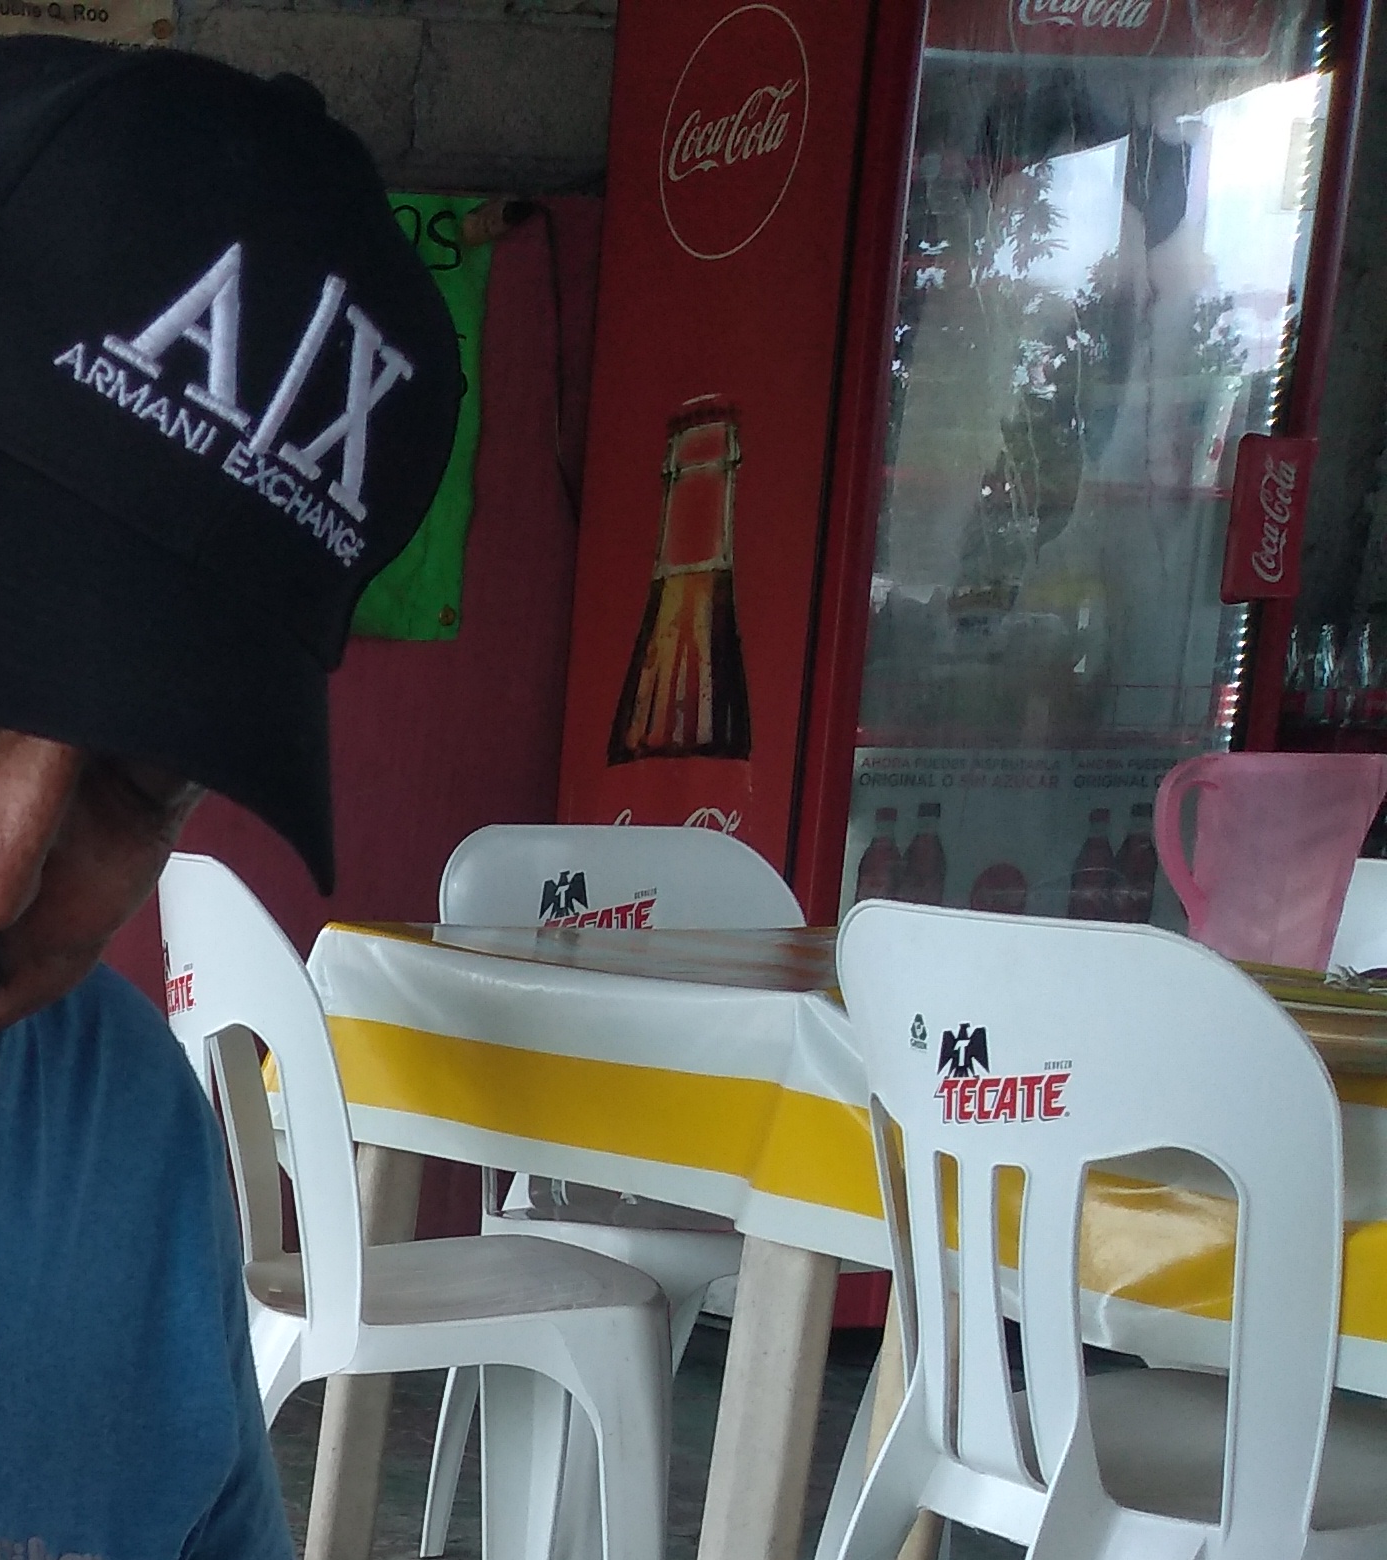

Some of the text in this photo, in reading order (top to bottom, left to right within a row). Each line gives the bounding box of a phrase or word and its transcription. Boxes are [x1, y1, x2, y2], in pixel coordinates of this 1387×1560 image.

[73, 4, 109, 23] Roo
[668, 78, 802, 182] Coca-Cola
[53, 341, 219, 456] ARMANI
[1252, 454, 1297, 583] Coca-Cola
[934, 1073, 1071, 1125] TECATE
